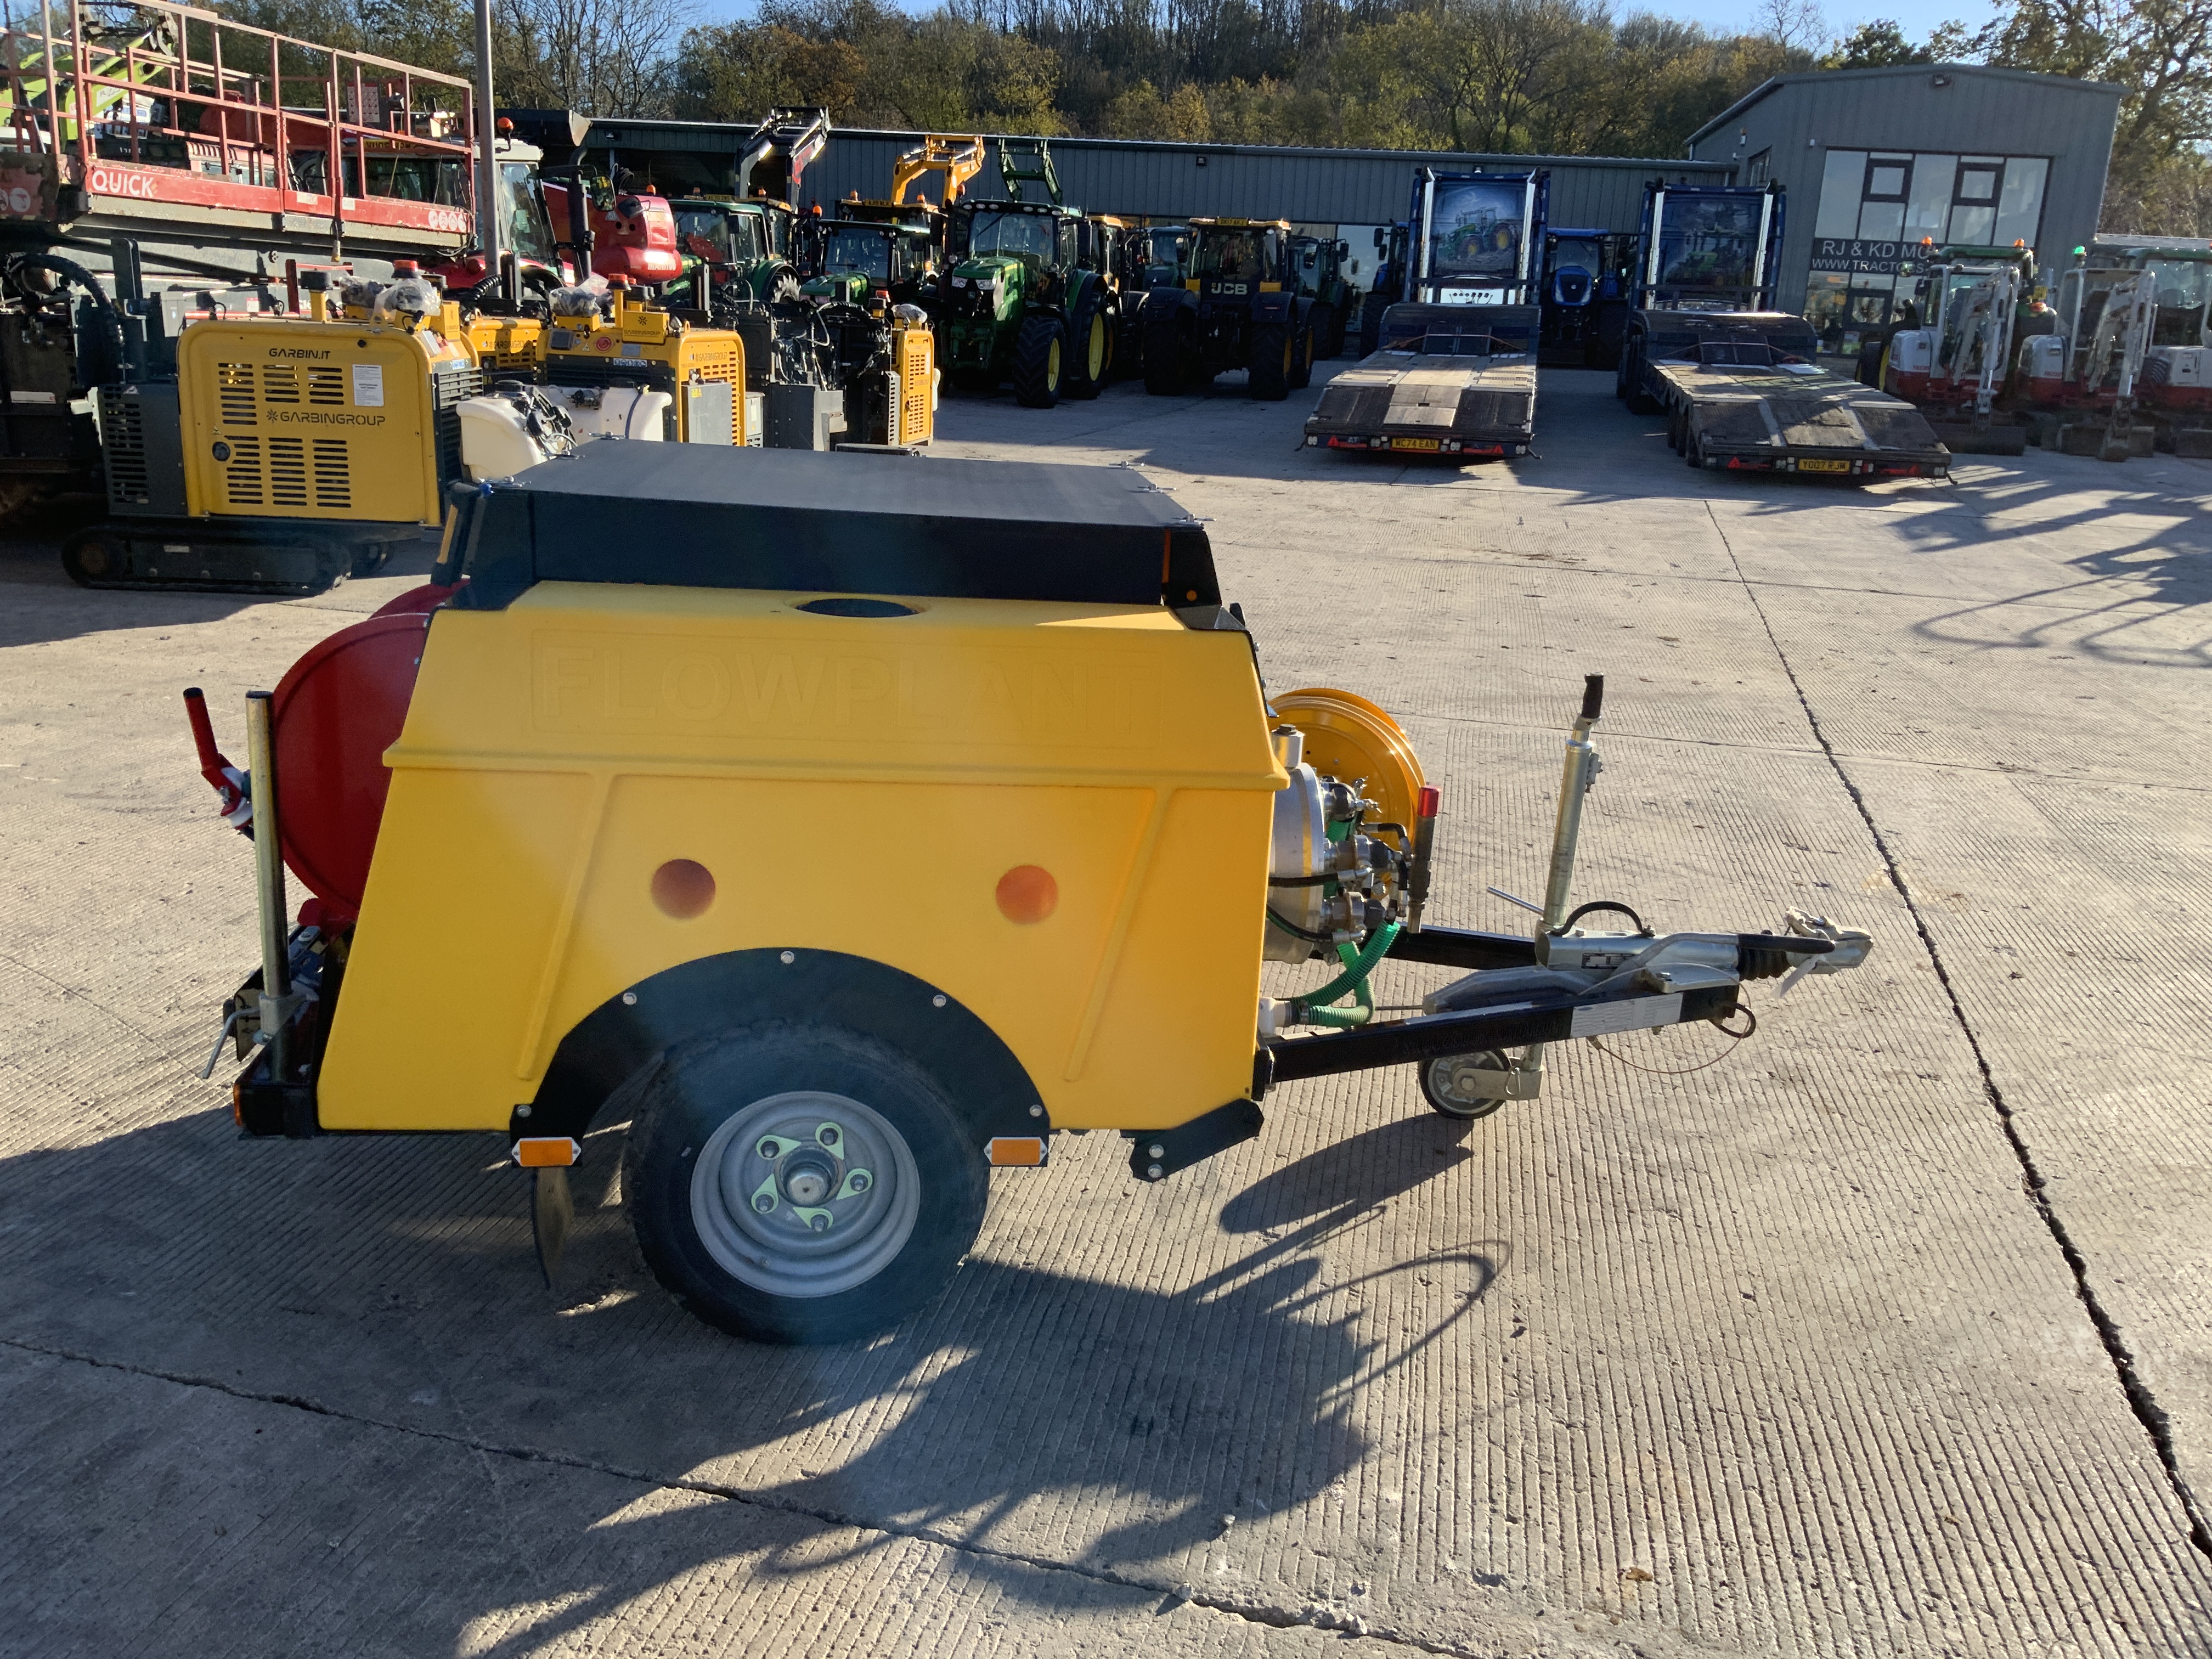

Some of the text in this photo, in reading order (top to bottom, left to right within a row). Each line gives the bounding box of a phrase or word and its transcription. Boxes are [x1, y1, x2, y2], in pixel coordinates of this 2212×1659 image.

[92, 170, 155, 198] QUICK
[1822, 240, 1845, 256] RJ
[1850, 241, 1862, 256] &
[1869, 243, 1895, 258] KD
[1211, 282, 1248, 295] JCB
[268, 347, 331, 360] GARBIN.IT
[280, 410, 386, 426] GARBINGROUP
[540, 644, 1152, 735] FLOWPLANT
